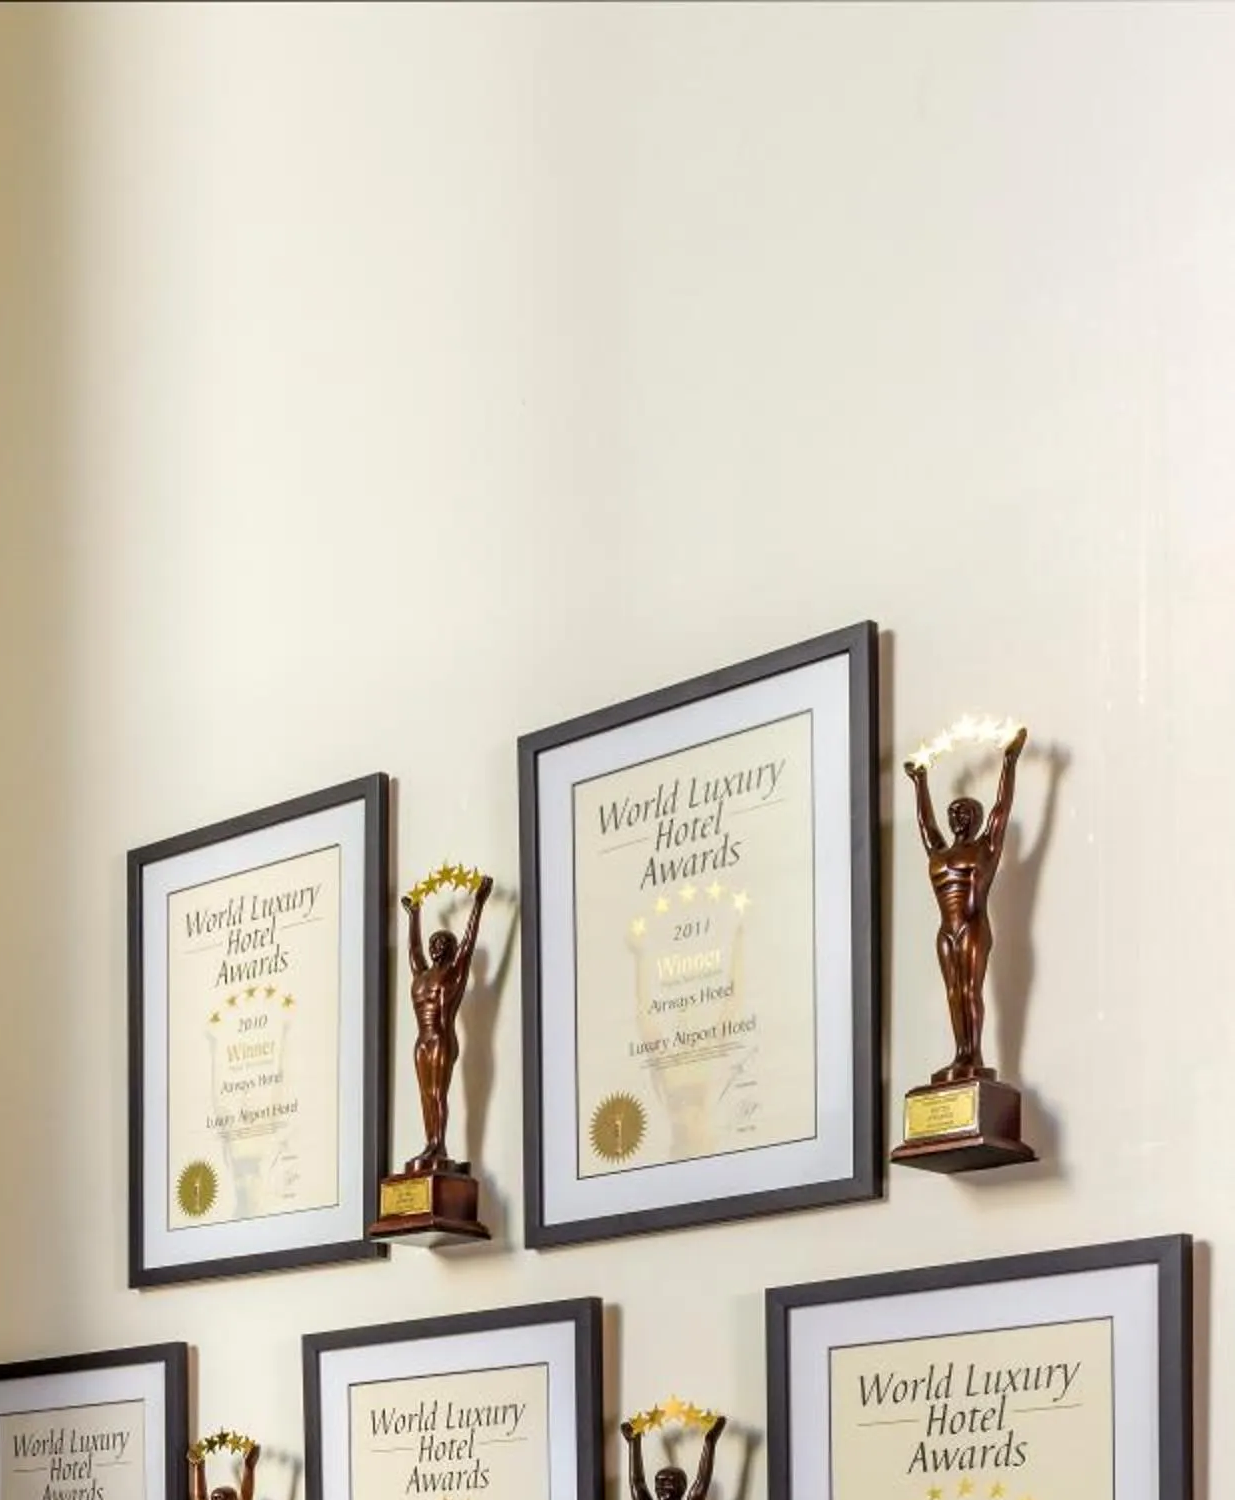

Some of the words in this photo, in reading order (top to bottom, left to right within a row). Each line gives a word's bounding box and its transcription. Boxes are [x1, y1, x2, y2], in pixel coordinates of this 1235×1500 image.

[599, 778, 680, 835] World
[688, 758, 786, 809] Luxury
[655, 800, 724, 852] Hotel
[640, 832, 743, 890] Awards
[185, 895, 244, 938] World
[250, 883, 322, 920] Luxury
[672, 918, 711, 941] 2011
[227, 913, 276, 956] Hotel
[215, 943, 289, 988] Awards
[657, 948, 722, 978] Winner
[647, 994, 697, 1015] Airways
[700, 981, 735, 1003] Hotel
[673, 1025, 717, 1047] Airport
[722, 1014, 757, 1039] Hotel
[226, 1040, 276, 1063] Winner
[859, 1361, 954, 1407] World
[966, 1361, 1081, 1402] Luxury
[371, 1399, 438, 1437] World
[445, 1401, 526, 1436] Luxury
[926, 1393, 1006, 1437] Hotel
[13, 1427, 64, 1457] World
[70, 1429, 130, 1459] Luxury
[418, 1427, 476, 1463] Hotel
[906, 1430, 1028, 1475] Awards
[50, 1453, 93, 1482] Hotel
[405, 1458, 490, 1495] Awards
